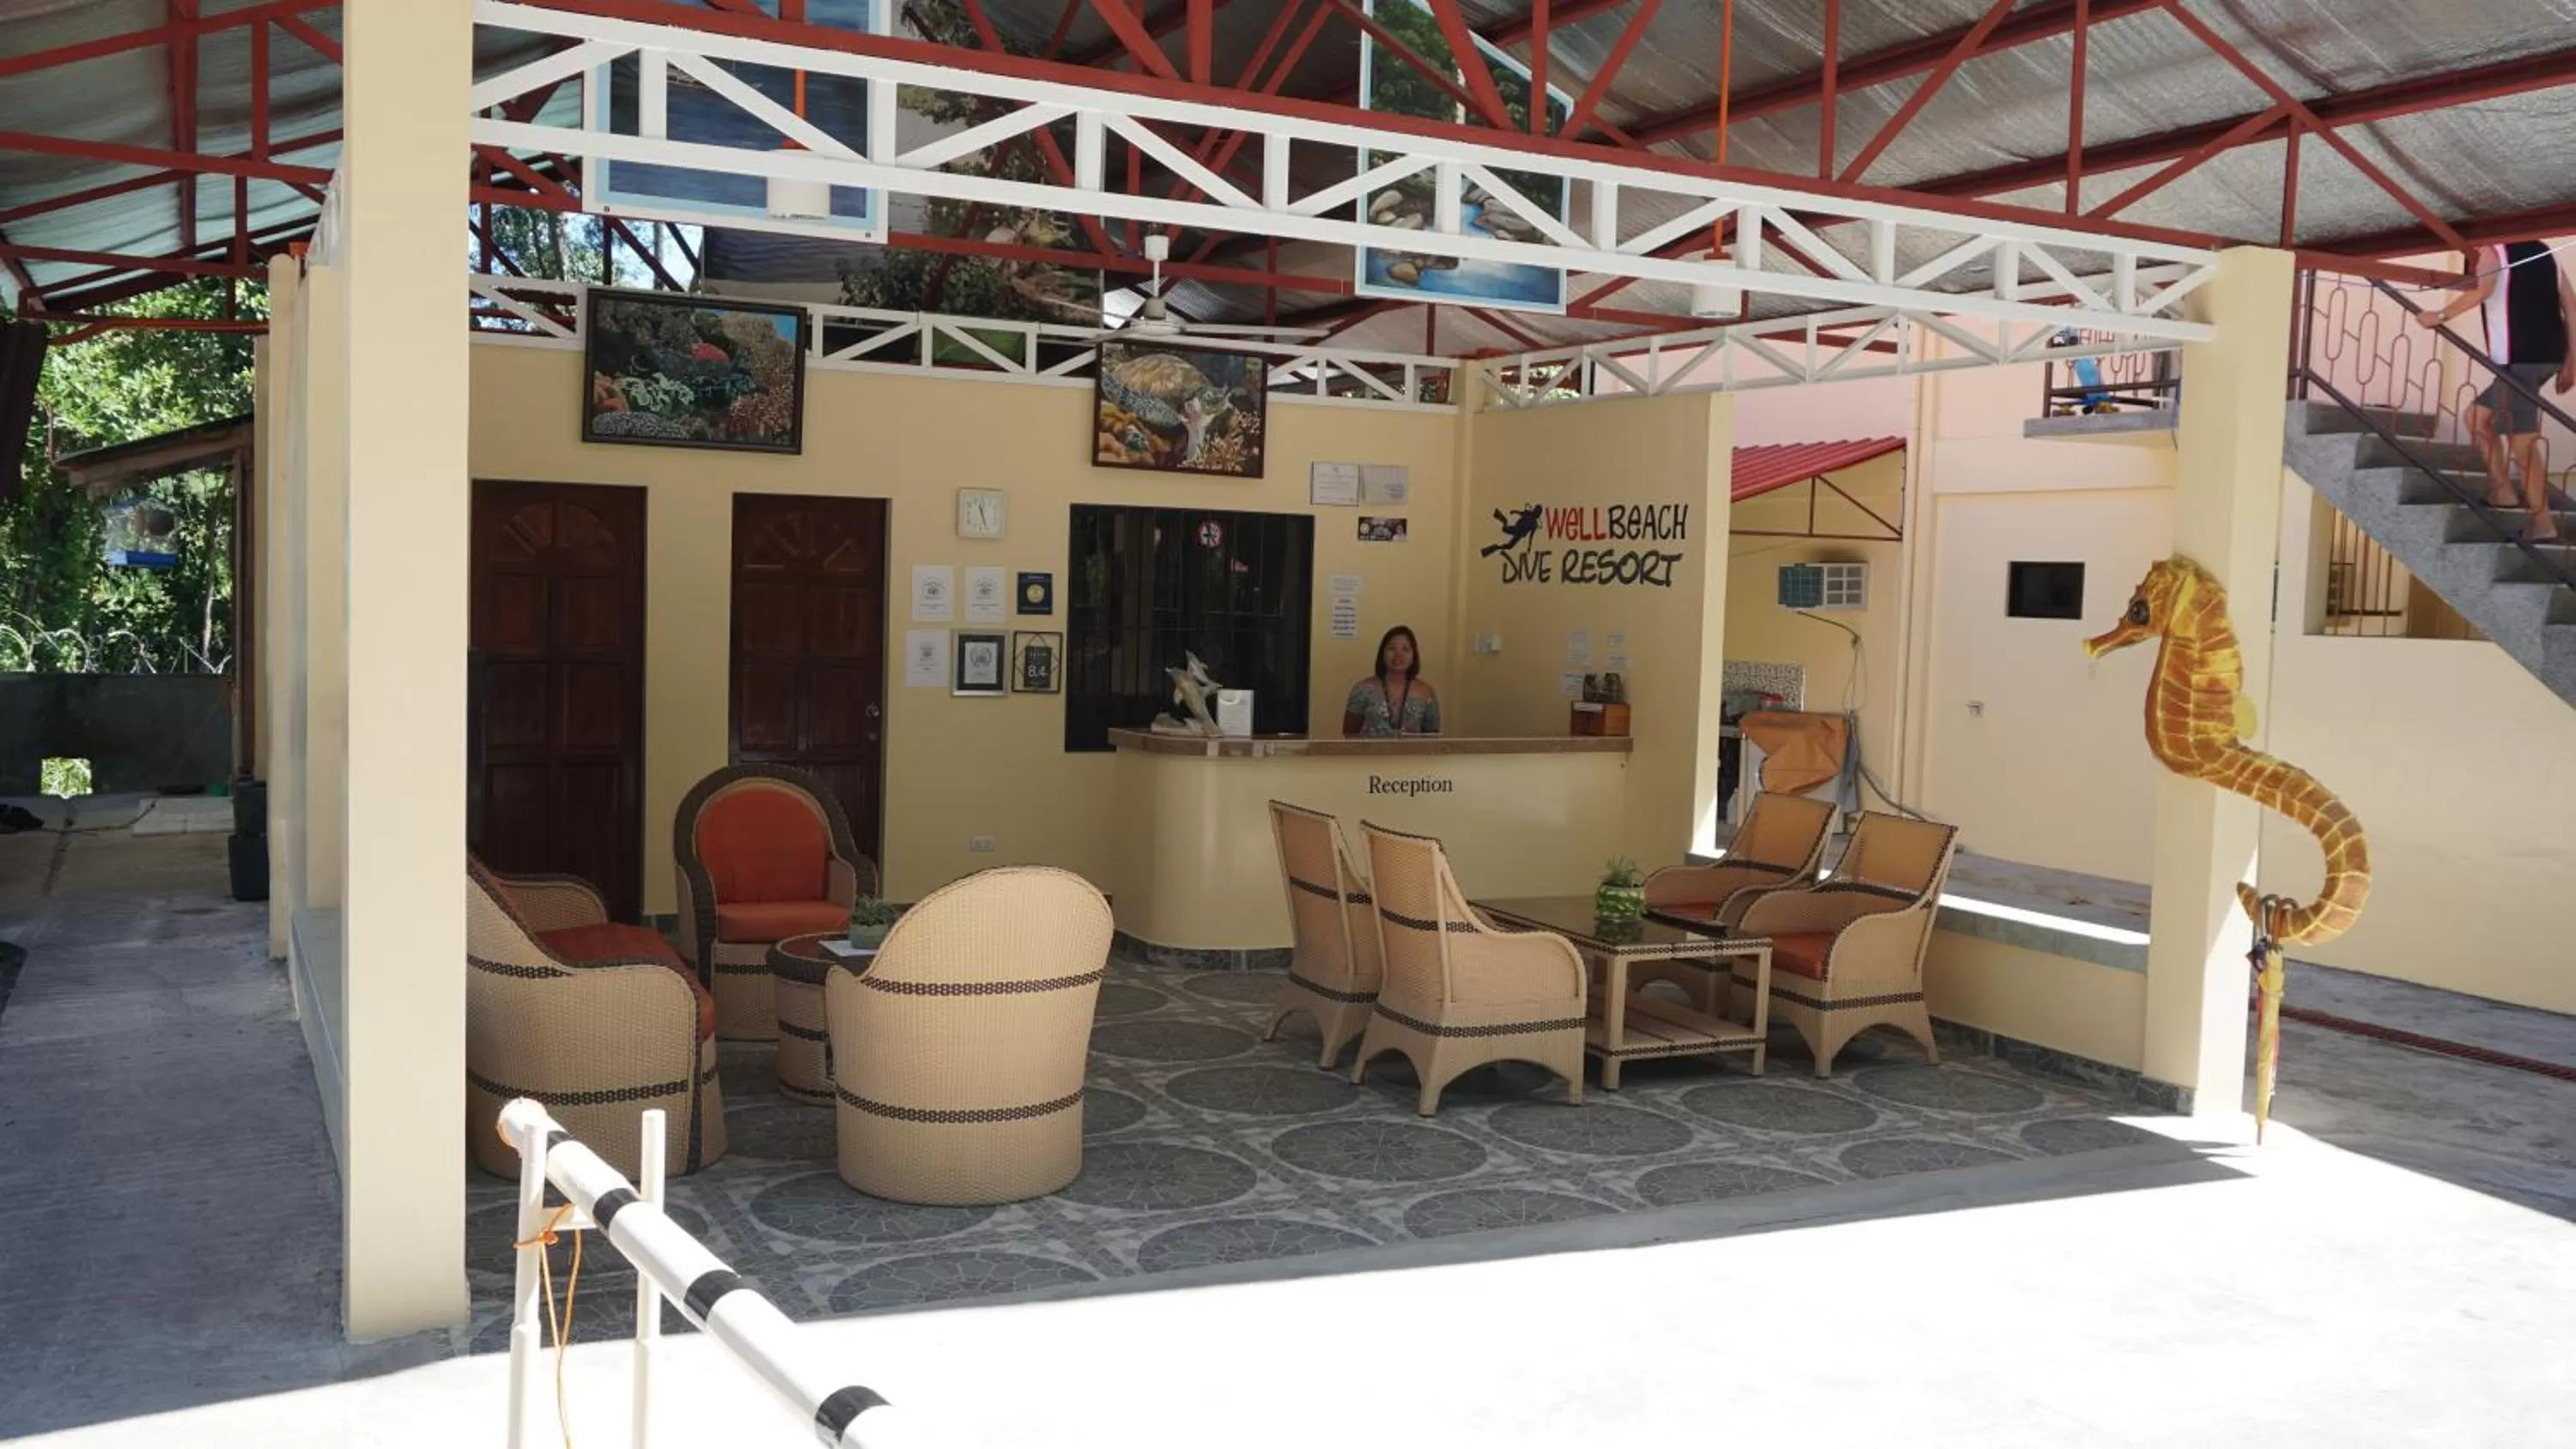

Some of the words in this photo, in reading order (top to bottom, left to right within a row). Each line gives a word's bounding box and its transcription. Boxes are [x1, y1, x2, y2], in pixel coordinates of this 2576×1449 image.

[1500, 550, 1552, 584] DIVE
[1561, 549, 1683, 587] RESORT
[1369, 775, 1453, 797] Reception
